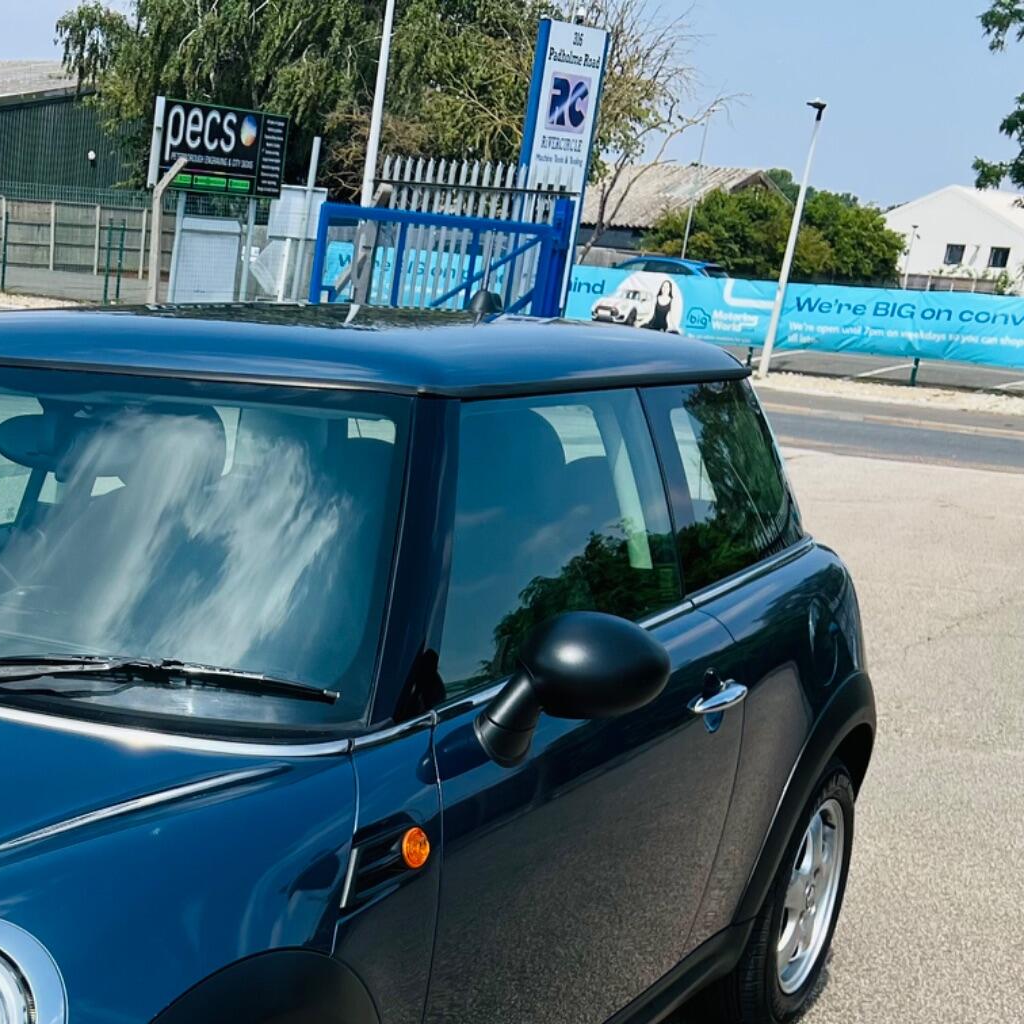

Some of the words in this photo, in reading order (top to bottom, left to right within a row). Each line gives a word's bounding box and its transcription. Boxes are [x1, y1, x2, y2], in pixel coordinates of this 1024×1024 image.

[548, 46, 583, 66] Padholme
[583, 53, 601, 69] Road
[164, 104, 237, 162] pecs
[712, 309, 759, 326] Motoring
[795, 296, 867, 317] We're
[872, 301, 916, 319] BIG
[920, 308, 953, 321] on
[788, 320, 815, 333] We're
[816, 324, 840, 336] open
[842, 325, 862, 335] until
